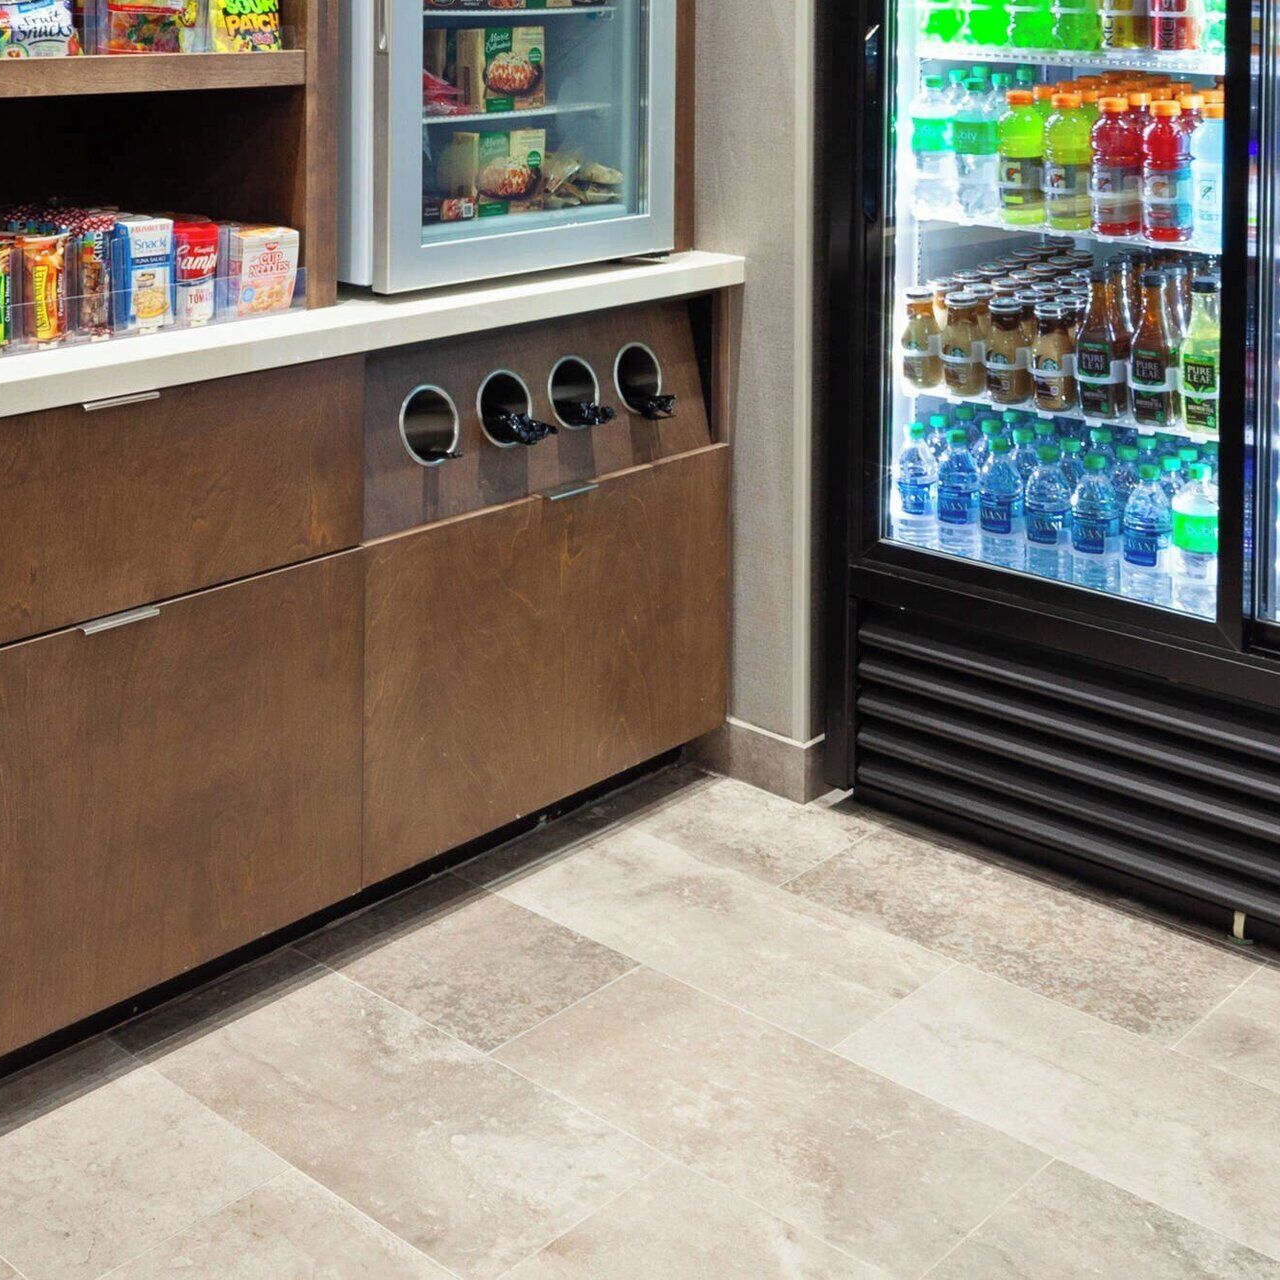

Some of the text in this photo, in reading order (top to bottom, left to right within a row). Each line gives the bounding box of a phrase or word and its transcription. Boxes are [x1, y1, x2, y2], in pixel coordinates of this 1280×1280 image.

[23, 11, 60, 27] Fruit
[223, 14, 279, 36] PATCH
[15, 24, 73, 42] Snacks
[93, 231, 104, 262] KIND
[260, 251, 284, 265] CUP
[248, 261, 291, 278] NOODLES
[1136, 360, 1159, 369] PURE
[1187, 365, 1211, 375] PURE
[1136, 368, 1160, 379] LEAF
[1187, 373, 1212, 384] LEAF
